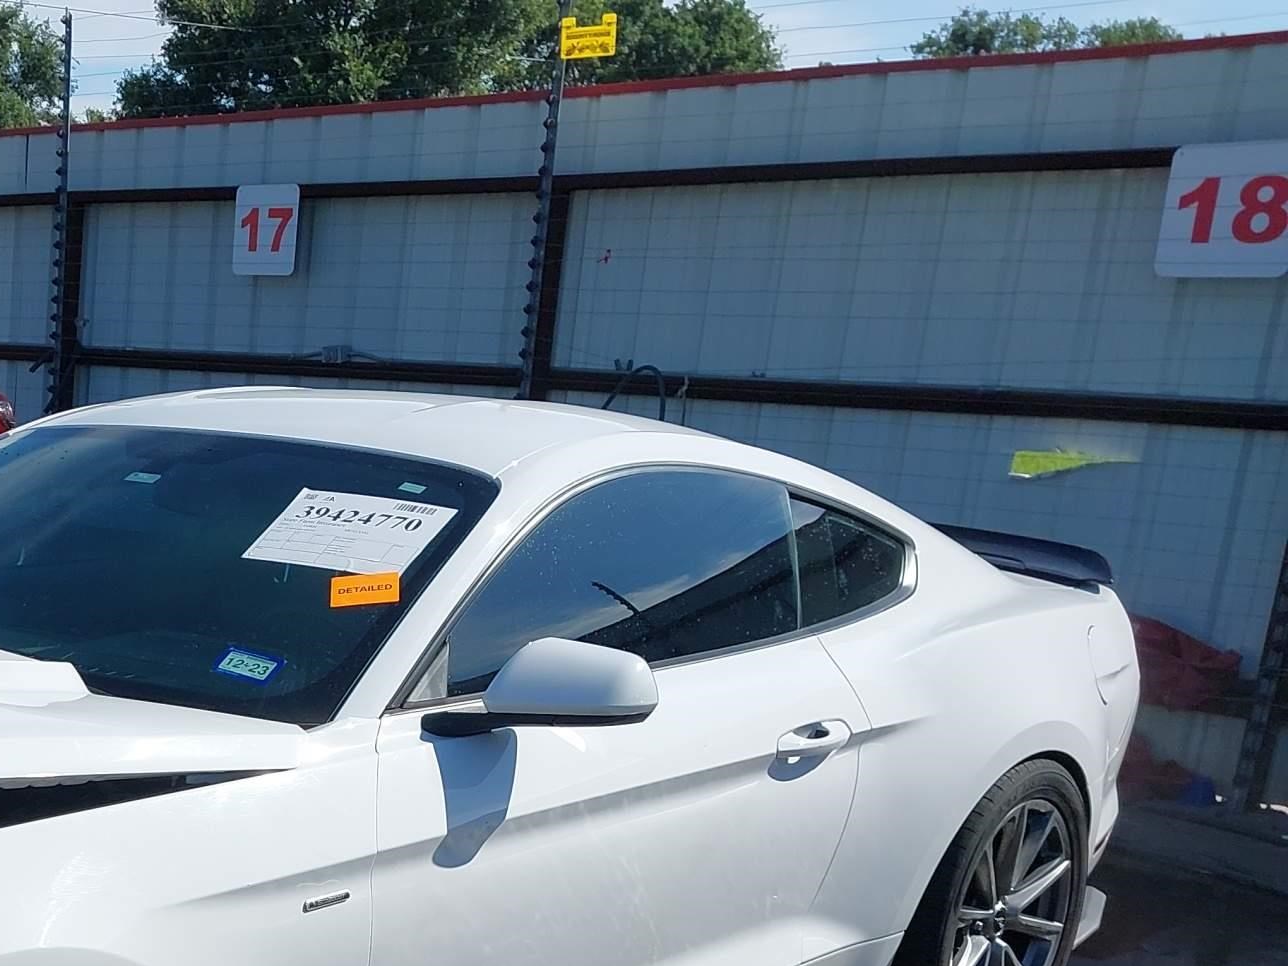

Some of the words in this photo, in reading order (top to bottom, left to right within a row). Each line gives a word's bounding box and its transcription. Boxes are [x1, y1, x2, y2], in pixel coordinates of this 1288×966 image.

[1177, 174, 1288, 245] 18
[240, 206, 294, 253] 17
[295, 505, 423, 532] 39424770
[337, 583, 393, 595] DETAILED
